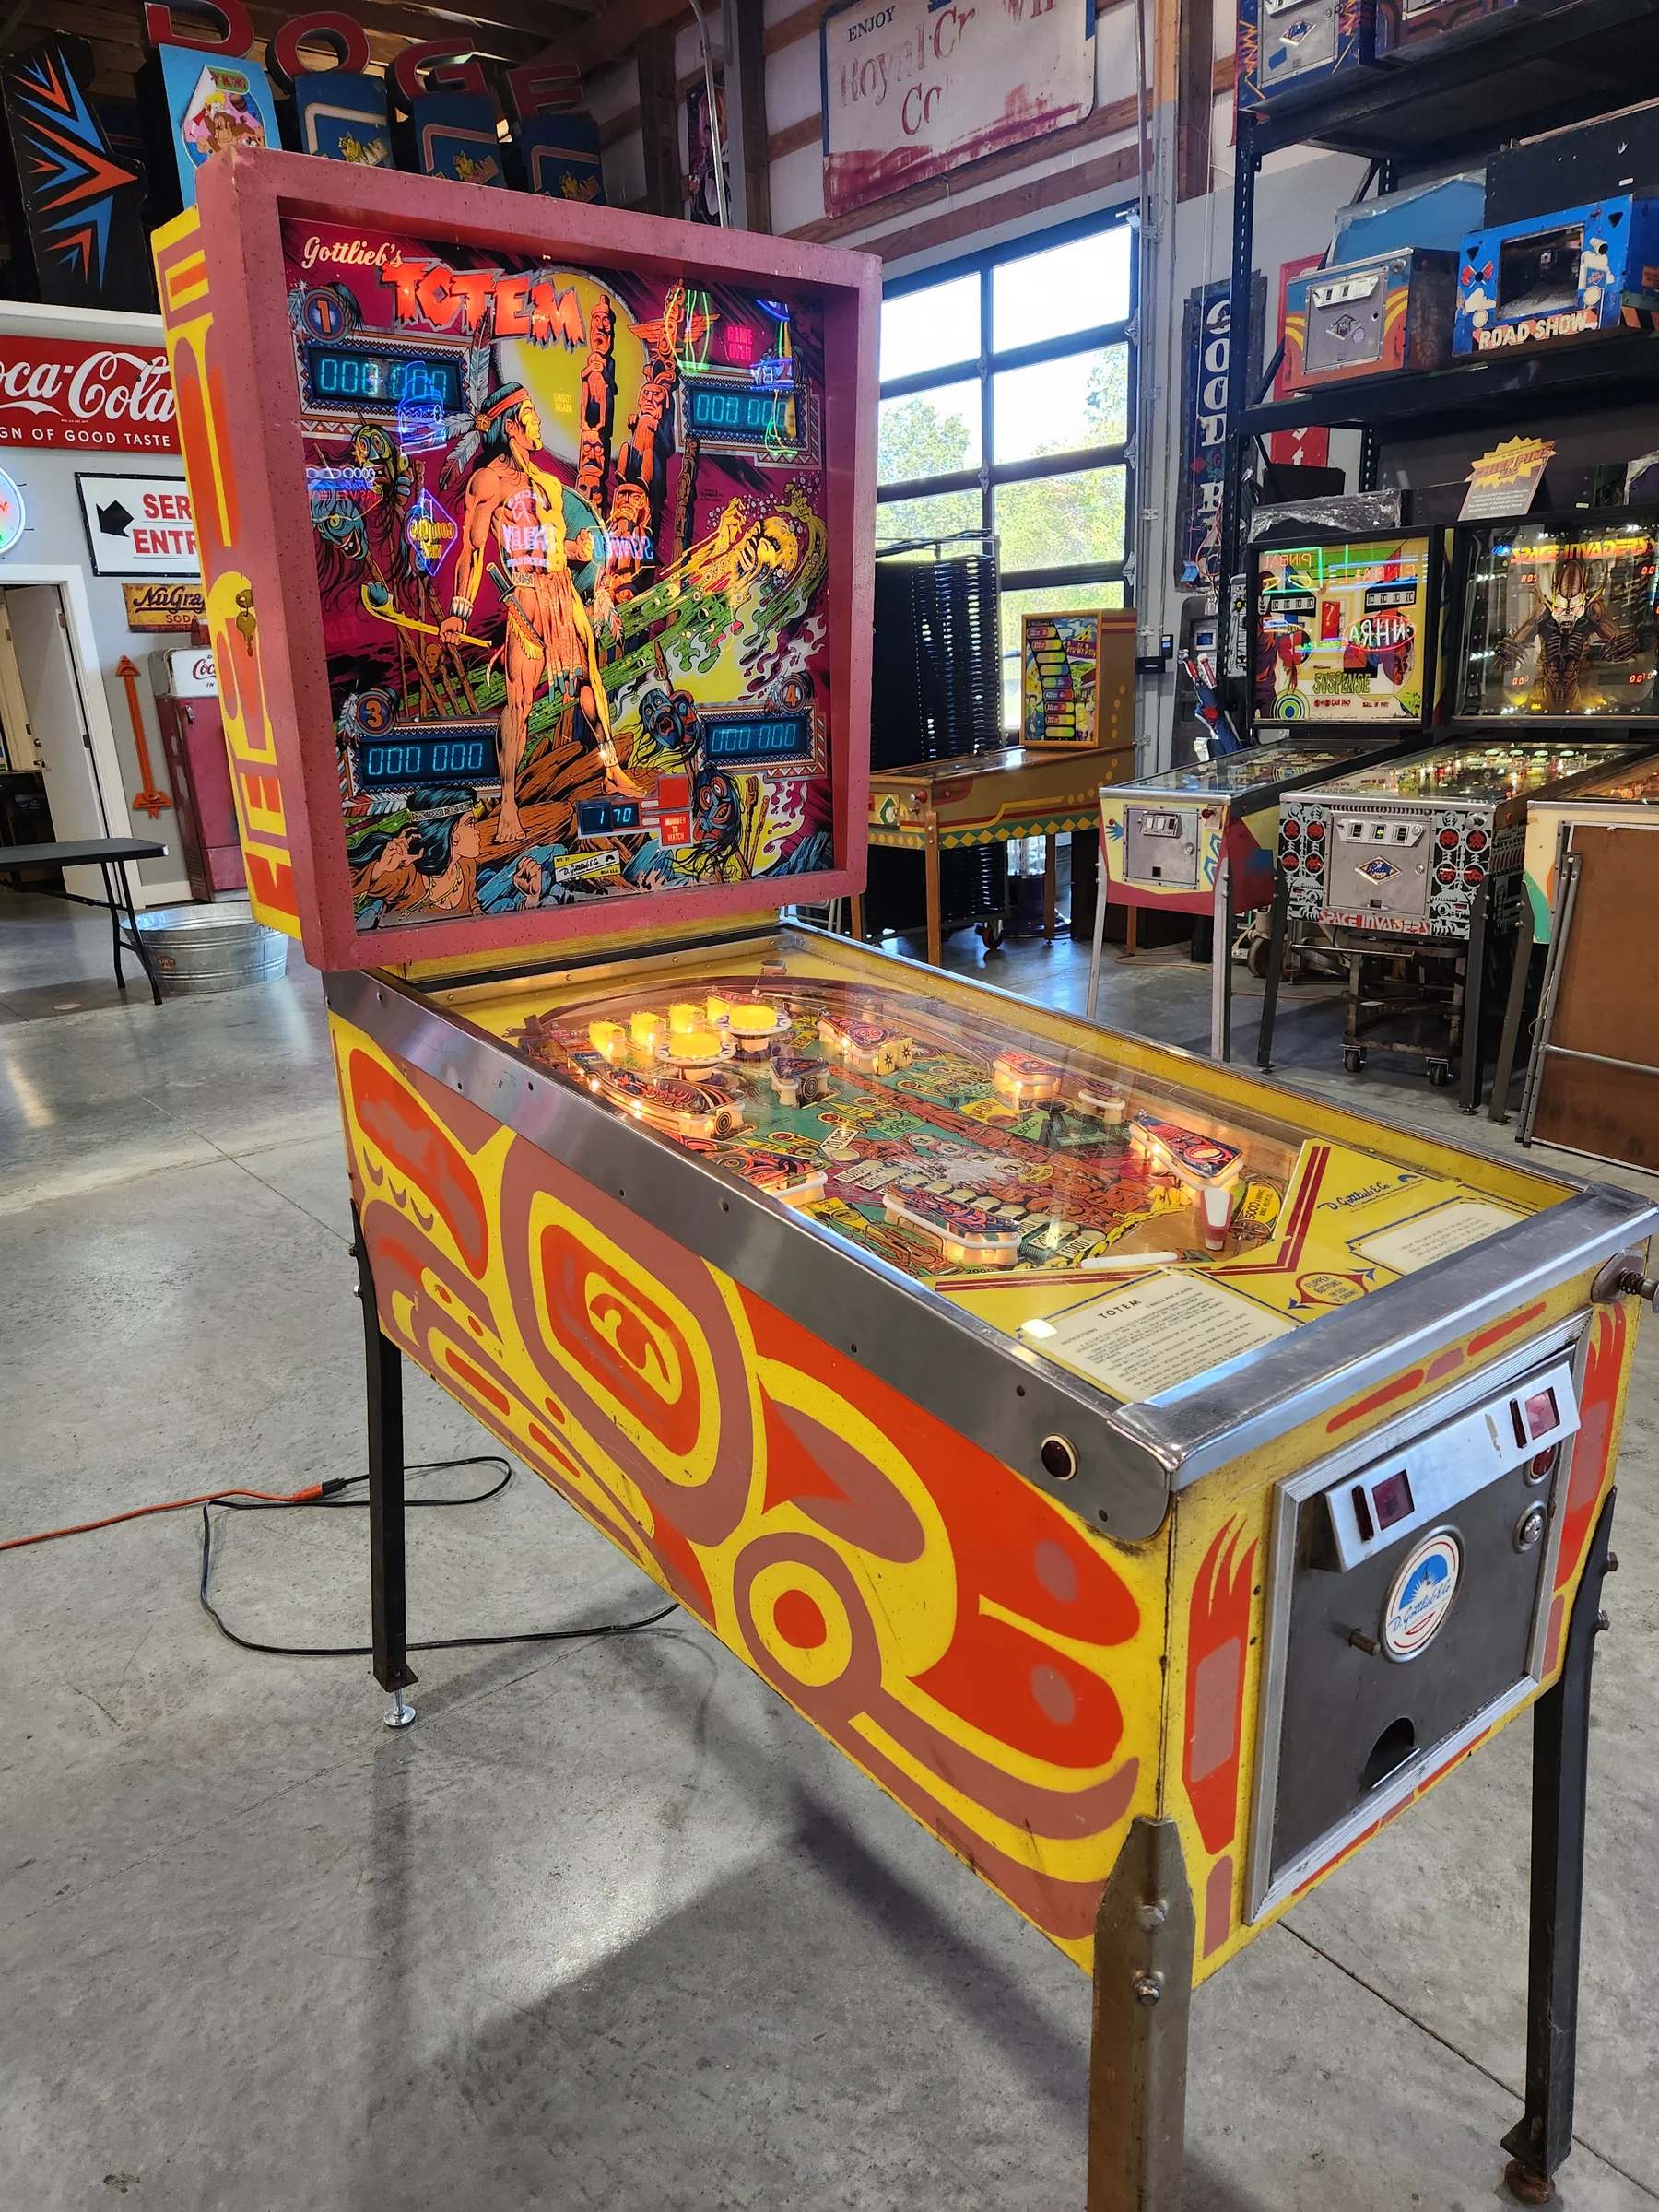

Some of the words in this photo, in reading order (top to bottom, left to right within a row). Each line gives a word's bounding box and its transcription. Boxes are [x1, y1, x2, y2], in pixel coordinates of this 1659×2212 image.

[848, 6, 896, 42] ENJOY
[301, 236, 403, 269] Gottlieb's
[380, 262, 586, 347] TOTEM
[316, 300, 332, 334] 1
[727, 326, 753, 344] GAME
[1478, 322, 1530, 350] ROAD
[1534, 311, 1588, 340] SHOW
[728, 345, 752, 361] OVER
[32, 428, 54, 442] OF
[65, 429, 116, 445] GOOD
[124, 433, 171, 448] TASTE
[1473, 457, 1516, 478] CHIEF
[1514, 446, 1552, 465] PINS
[1511, 546, 1560, 564] SPACE
[1560, 537, 1651, 559] INVADERS
[166, 615, 199, 623] SODA
[1312, 671, 1371, 694] SUSPENSE
[784, 685, 798, 706] 4
[365, 700, 383, 726] 3
[665, 816, 687, 826] NUMBER
[672, 825, 679, 833] TO
[667, 832, 685, 842] MATCH
[1318, 911, 1358, 926] SPACE
[1361, 914, 1430, 935] INVADERS
[1336, 1185, 1373, 1207] Gottlieb
[1376, 1182, 1393, 1191] Co.
[1245, 1202, 1260, 1219] 5000
[1062, 1240, 1090, 1255] 1000
[1304, 1276, 1330, 1288] FLIPPER
[1098, 1299, 1142, 1319] TOTEM
[1404, 1586, 1435, 1630] Gottlieb
